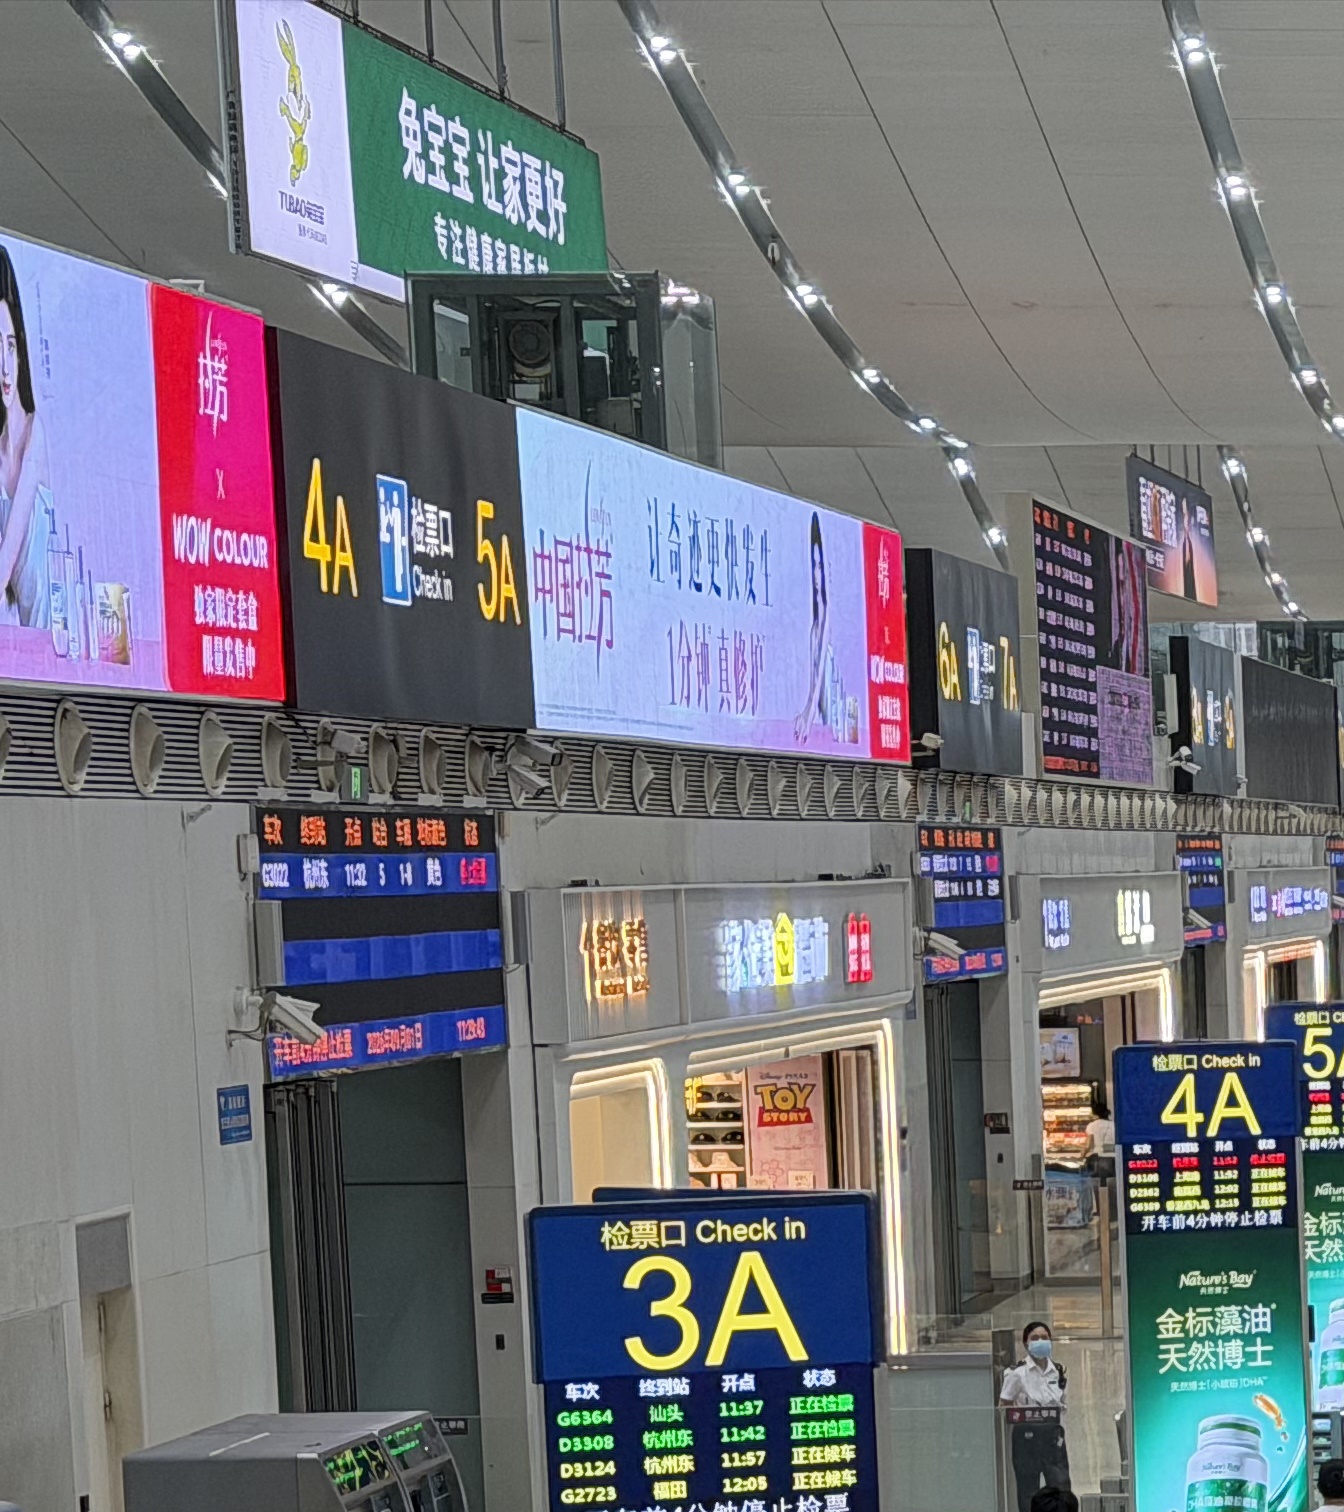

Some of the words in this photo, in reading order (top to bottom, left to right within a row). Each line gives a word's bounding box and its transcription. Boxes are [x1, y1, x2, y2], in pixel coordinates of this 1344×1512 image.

[397, 86, 474, 203] 兔宝宝
[476, 128, 567, 245] 让家更好
[172, 513, 212, 566] WOW
[214, 530, 268, 569] COLOUR
[303, 457, 359, 598] 4A
[411, 496, 454, 560] 检票口
[476, 500, 522, 626] 5A
[647, 497, 773, 608] 让奇迹更快发生
[413, 564, 439, 600] Check
[441, 571, 454, 602] in
[202, 634, 256, 680] 限量发售中
[667, 620, 710, 714] 1分钟
[938, 622, 962, 701] 6A
[1000, 636, 1019, 712] 7A
[1294, 1012, 1329, 1025] 检票口
[1152, 1054, 1197, 1071] 检票口
[1202, 1054, 1244, 1069] Check
[1248, 1053, 1261, 1067] in
[754, 1082, 816, 1112] TOY
[1160, 1072, 1262, 1138] 4A
[762, 1111, 808, 1123] STORY
[601, 1221, 686, 1252] 检票口
[695, 1219, 777, 1243] Check
[784, 1217, 806, 1239] in
[1141, 1209, 1283, 1232] 开车前4分钟停止检票
[1179, 1271, 1227, 1289] Nature's
[1229, 1271, 1254, 1287] Bay
[622, 1251, 810, 1371] 3A
[1158, 1340, 1273, 1374] 天然博士
[565, 1383, 601, 1401] 车次
[639, 1378, 691, 1397] 终到站
[721, 1374, 756, 1393] 开点
[803, 1369, 837, 1388] 状态
[557, 1411, 613, 1427] G6364
[649, 1404, 684, 1424] 汕头
[719, 1400, 764, 1418] 11:37
[558, 1438, 614, 1453] D3308
[642, 1429, 694, 1450] 杭州东
[720, 1426, 766, 1443] 11:42
[560, 1462, 616, 1479] D3124
[643, 1455, 695, 1475] 杭州东
[721, 1451, 766, 1469] 11:57
[791, 1445, 857, 1465] 正在候车
[561, 1487, 617, 1505] G2723
[652, 1481, 688, 1501] 福田
[722, 1477, 768, 1493] 12:05
[792, 1470, 858, 1492] 正在候车
